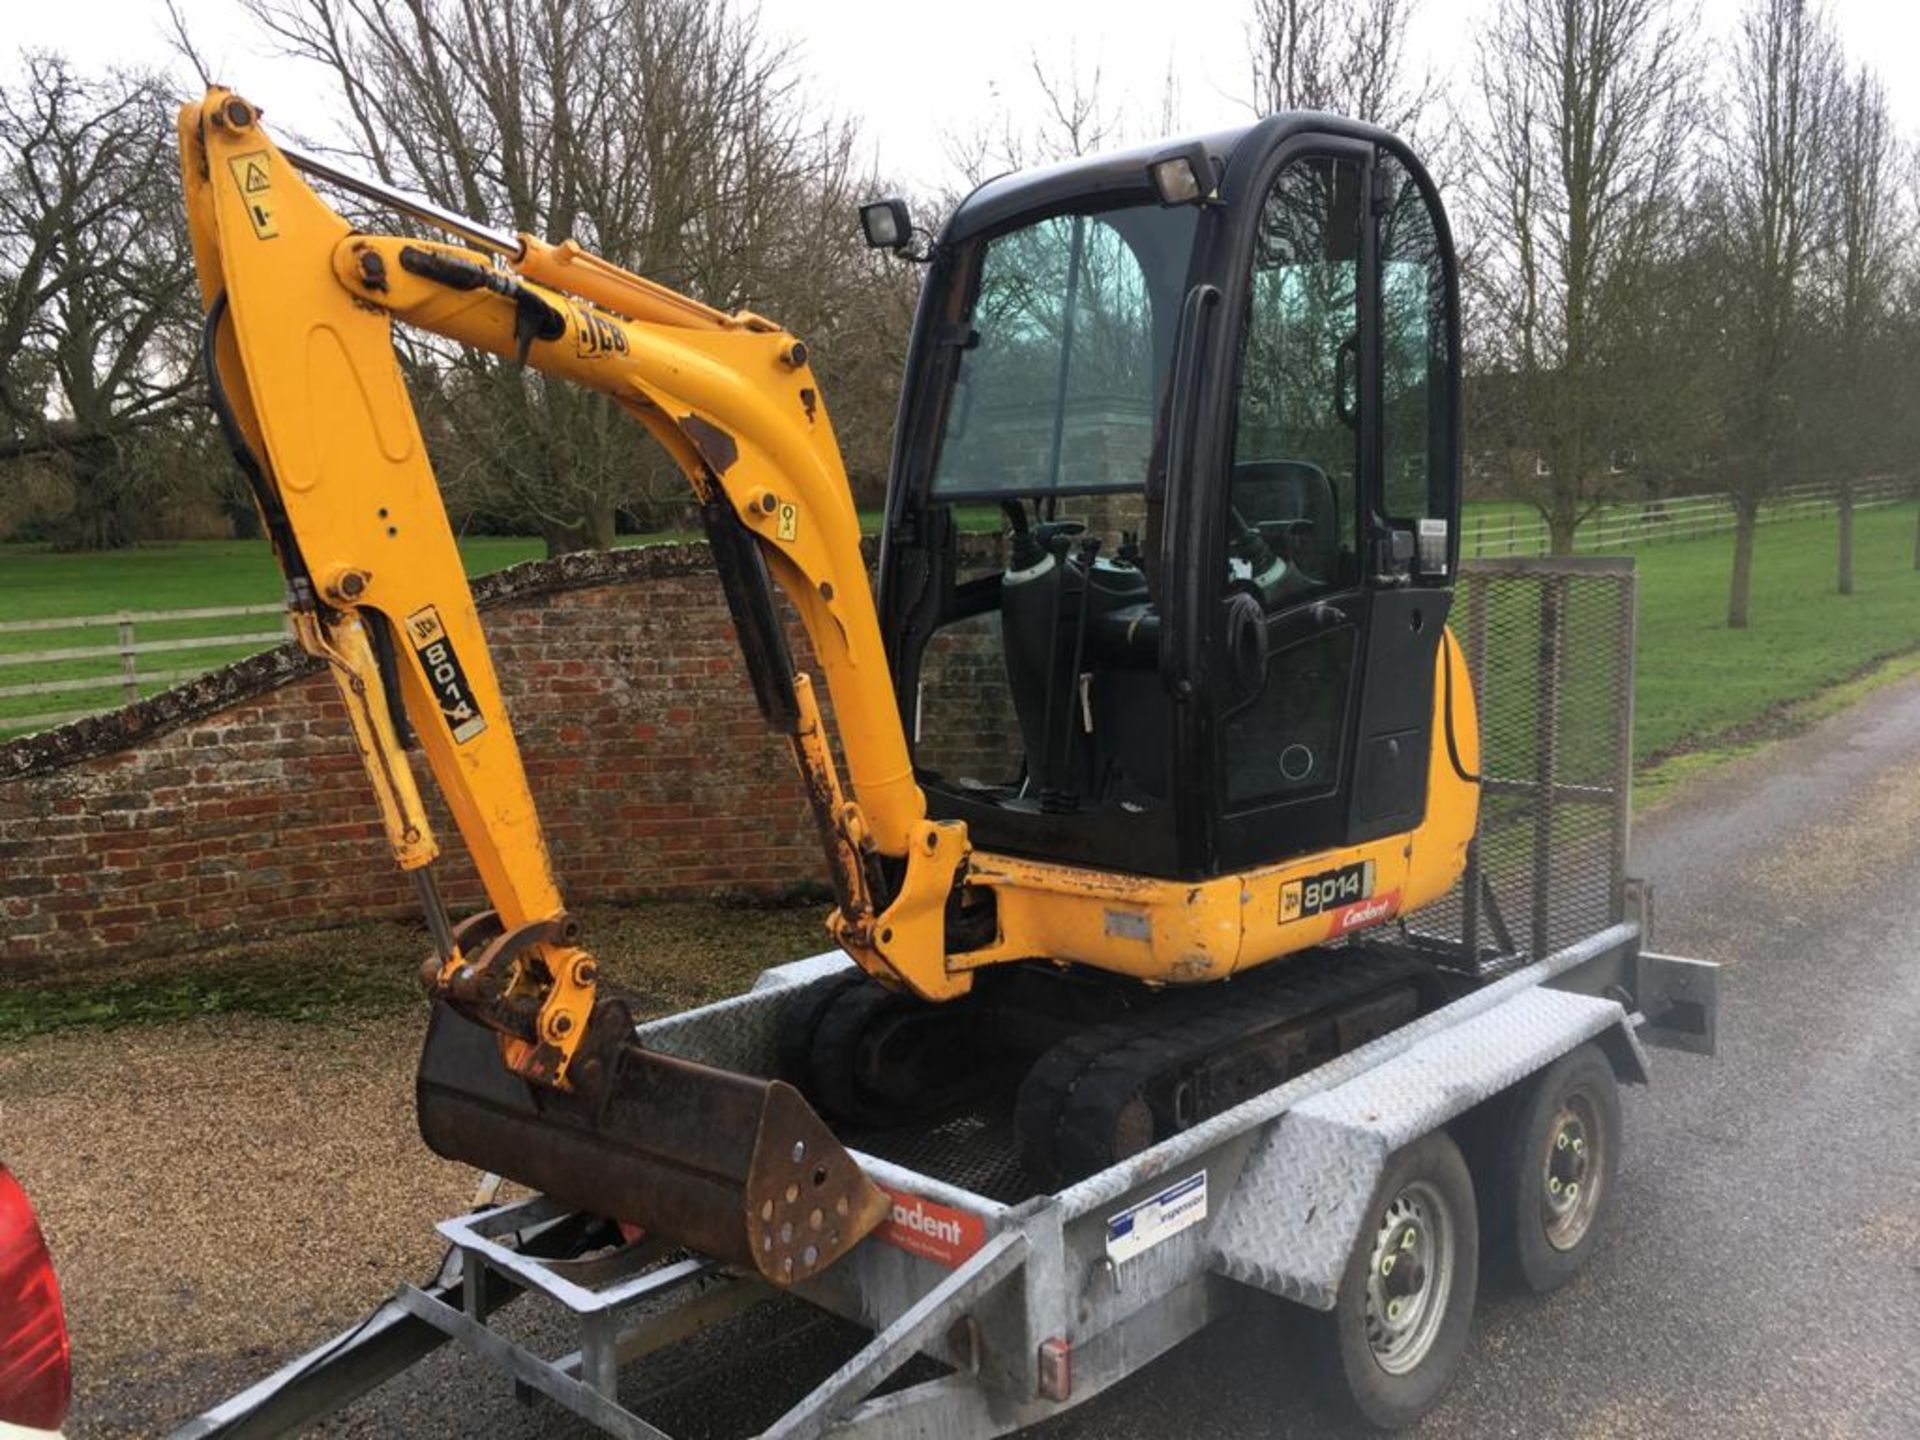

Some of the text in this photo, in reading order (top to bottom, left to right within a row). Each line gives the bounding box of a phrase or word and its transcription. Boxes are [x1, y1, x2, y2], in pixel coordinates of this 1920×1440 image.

[580, 309, 626, 354] JCB
[1304, 871, 1359, 908] 8014
[887, 1201, 962, 1246] adent
